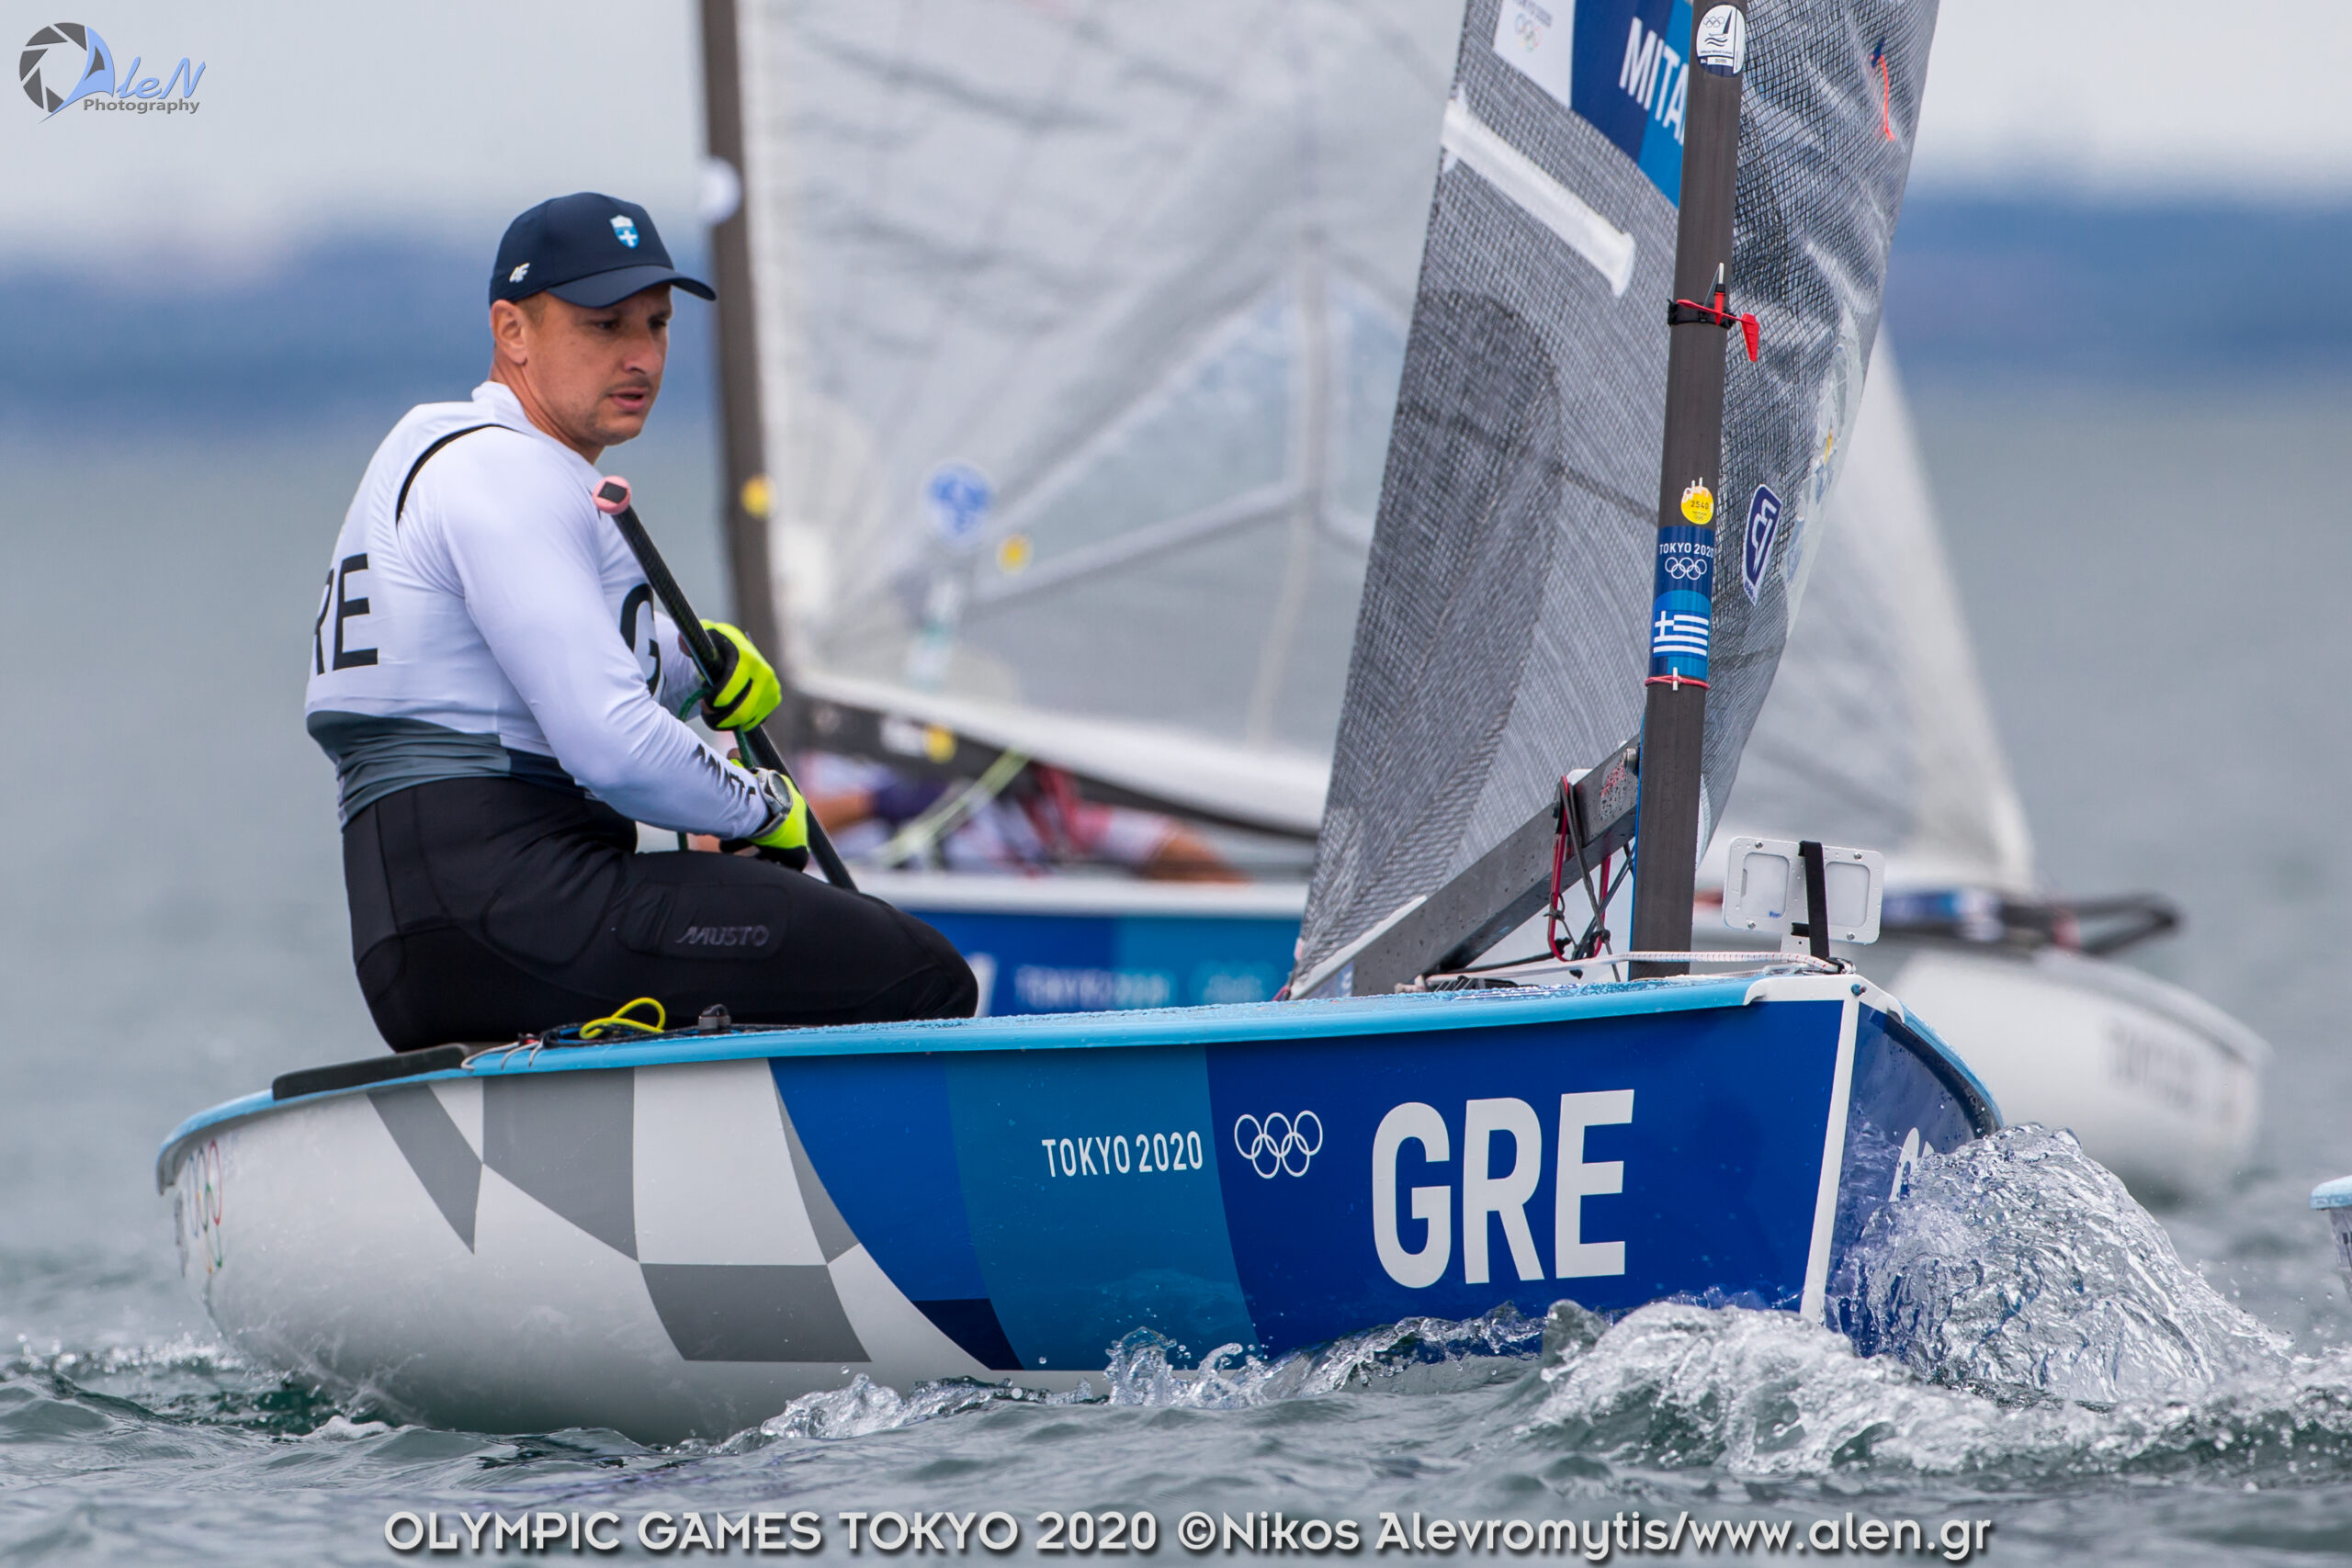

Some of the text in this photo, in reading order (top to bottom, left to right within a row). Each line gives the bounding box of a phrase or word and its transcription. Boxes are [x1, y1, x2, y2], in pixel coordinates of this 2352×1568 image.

[1619, 16, 1689, 146] MITA
[1659, 542, 1714, 558] TOKYO 2020
[675, 925, 770, 947] MUSTO
[1042, 1131, 1203, 1178] TOKYO 2020
[1373, 1089, 1634, 1288] GRE
